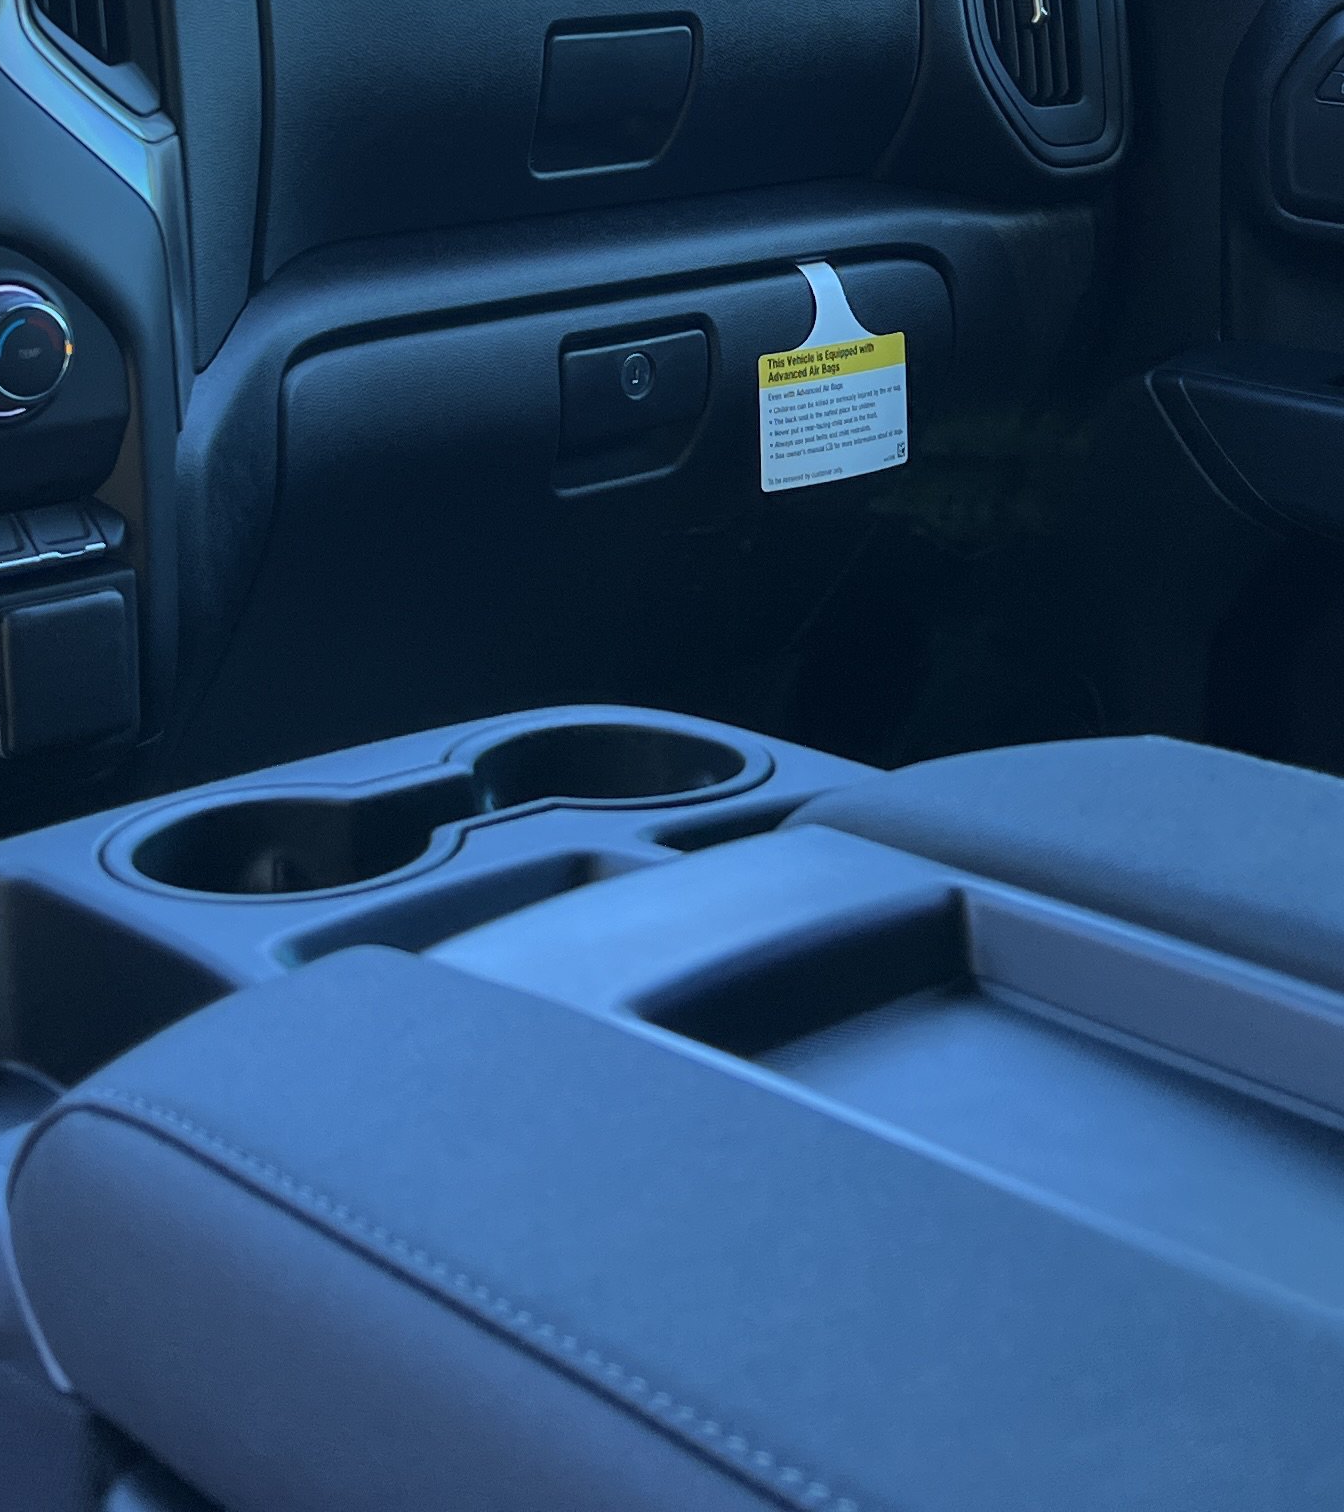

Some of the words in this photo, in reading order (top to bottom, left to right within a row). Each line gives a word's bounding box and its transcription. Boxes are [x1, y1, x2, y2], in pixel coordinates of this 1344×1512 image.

[767, 357, 785, 370] This
[787, 352, 815, 367] Vehicle
[816, 350, 823, 361] is
[825, 345, 857, 362] Equipped
[859, 343, 875, 354] with
[768, 367, 807, 383] Advanced
[809, 365, 819, 376] Air
[822, 361, 840, 376] Bags
